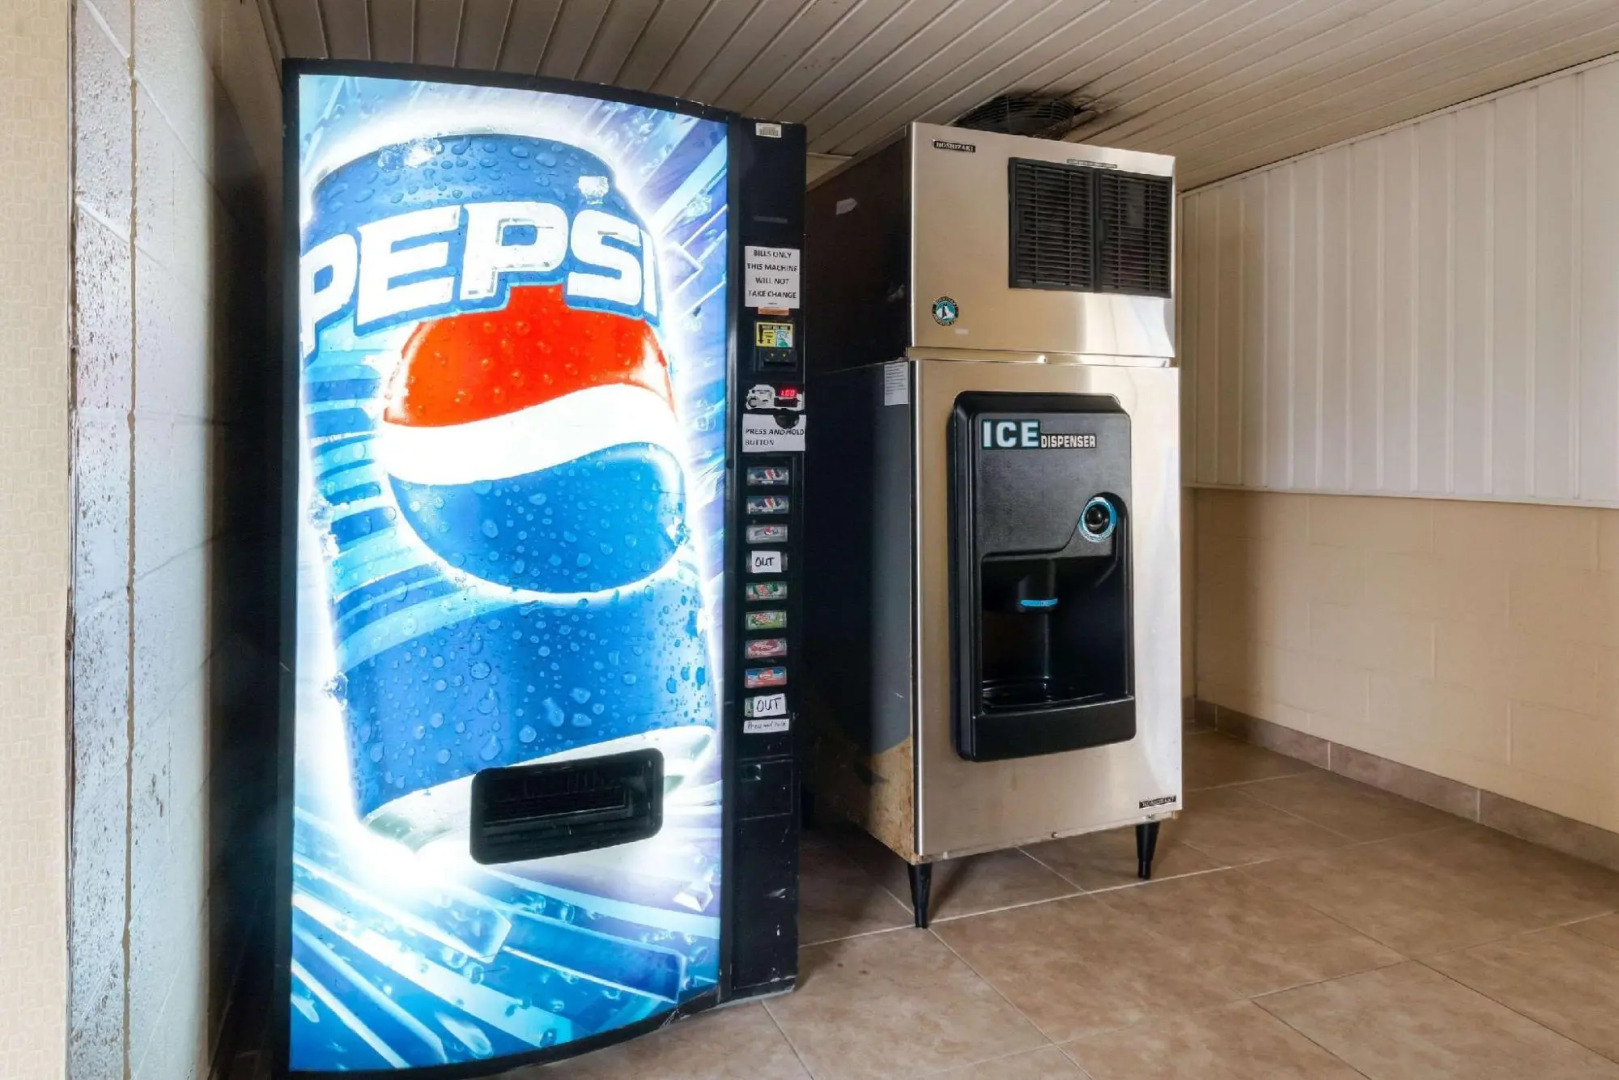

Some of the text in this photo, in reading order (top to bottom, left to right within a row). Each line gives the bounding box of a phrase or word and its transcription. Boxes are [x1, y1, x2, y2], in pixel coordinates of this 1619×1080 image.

[753, 249, 792, 259] BILLS ONLY
[747, 262, 798, 272] THIS MACHINE
[300, 200, 660, 355] PEPSI
[767, 291, 797, 299] CHANGE
[983, 421, 1096, 448] ICE DISPENSER
[755, 556, 775, 567] OUT
[756, 697, 782, 713] OUT
